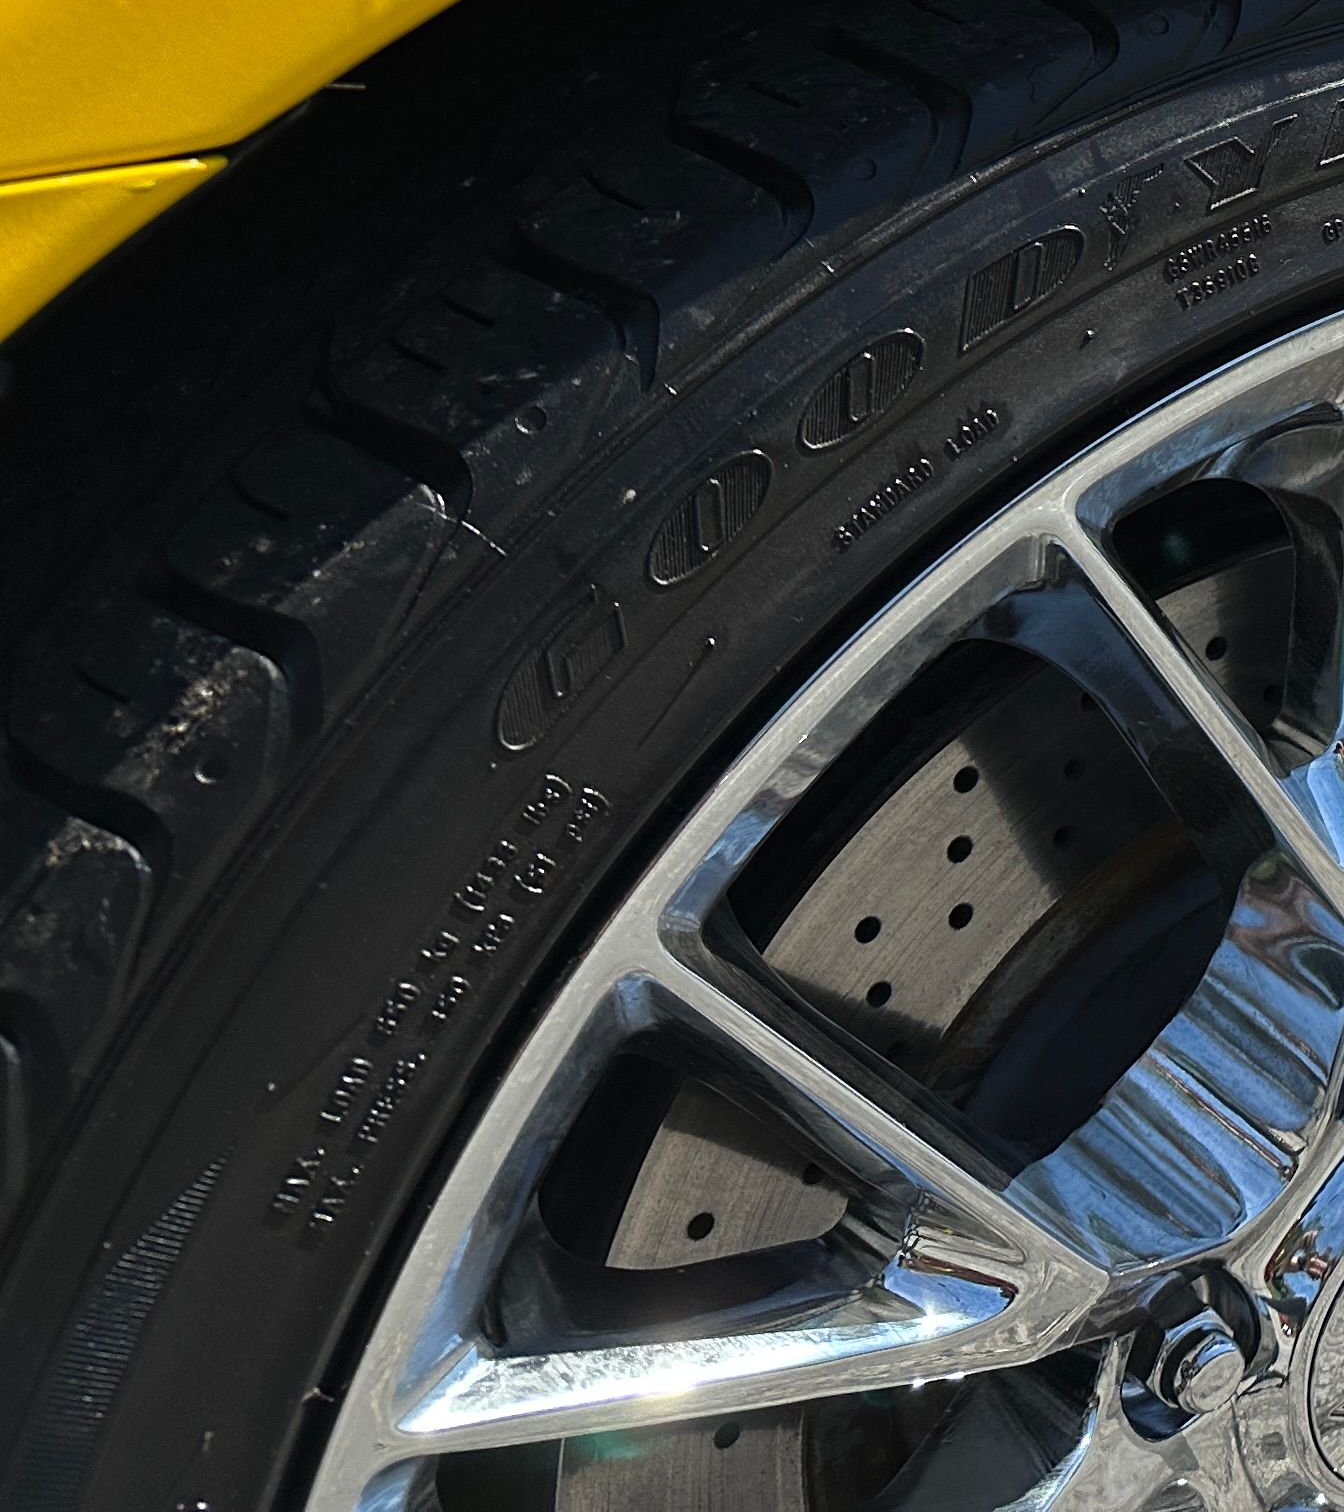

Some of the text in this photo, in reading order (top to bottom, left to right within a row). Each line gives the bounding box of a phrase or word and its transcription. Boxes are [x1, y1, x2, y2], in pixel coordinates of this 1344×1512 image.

[832, 409, 1001, 554] STANDARD LOAD
[320, 1056, 374, 1123] LOAD
